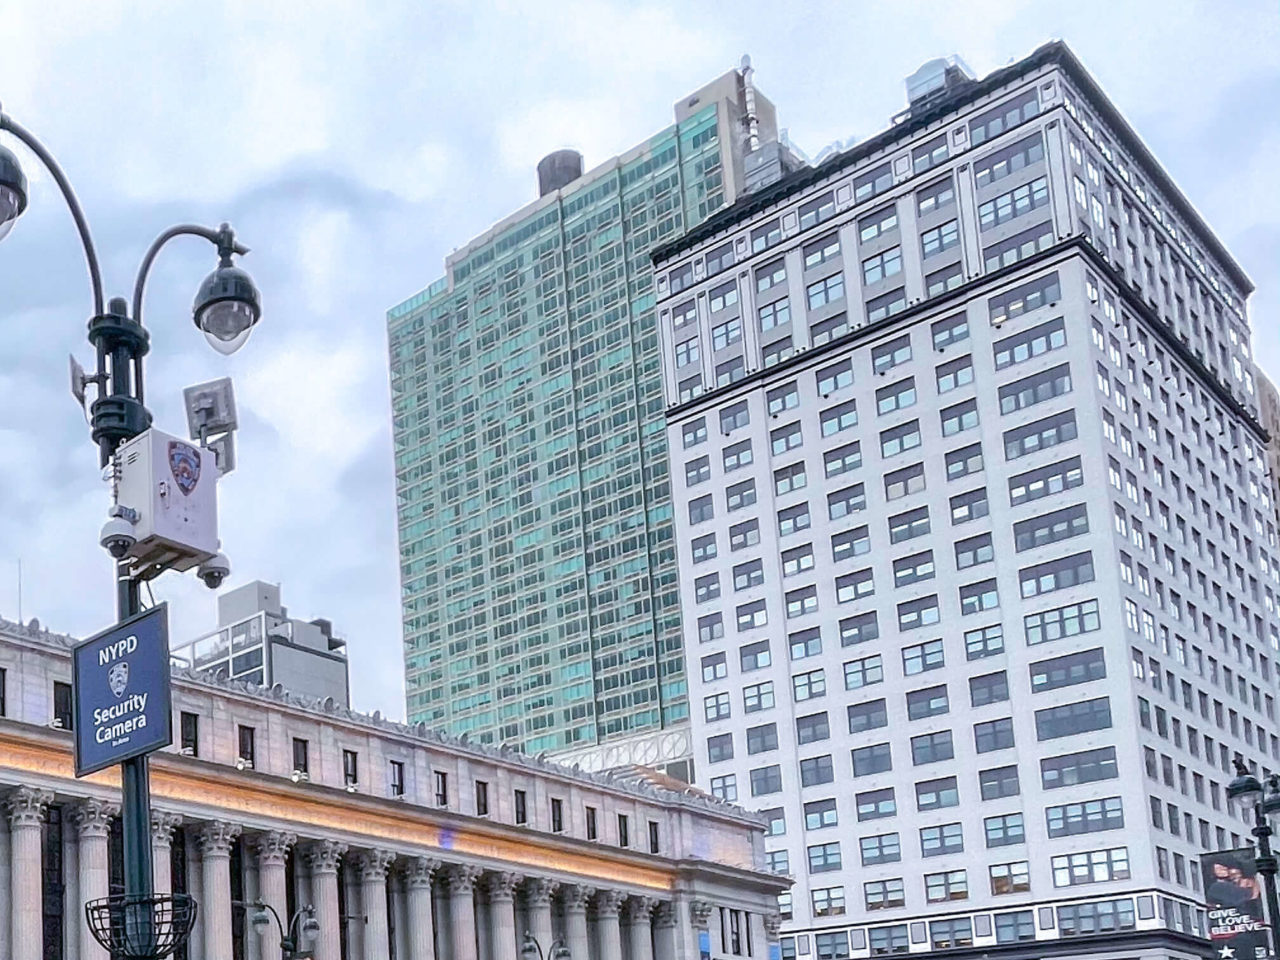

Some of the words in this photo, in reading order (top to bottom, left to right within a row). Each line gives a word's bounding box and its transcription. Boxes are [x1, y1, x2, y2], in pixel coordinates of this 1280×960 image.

[99, 635, 138, 666] NYPD
[94, 692, 148, 725] Security
[96, 714, 147, 743] Camera
